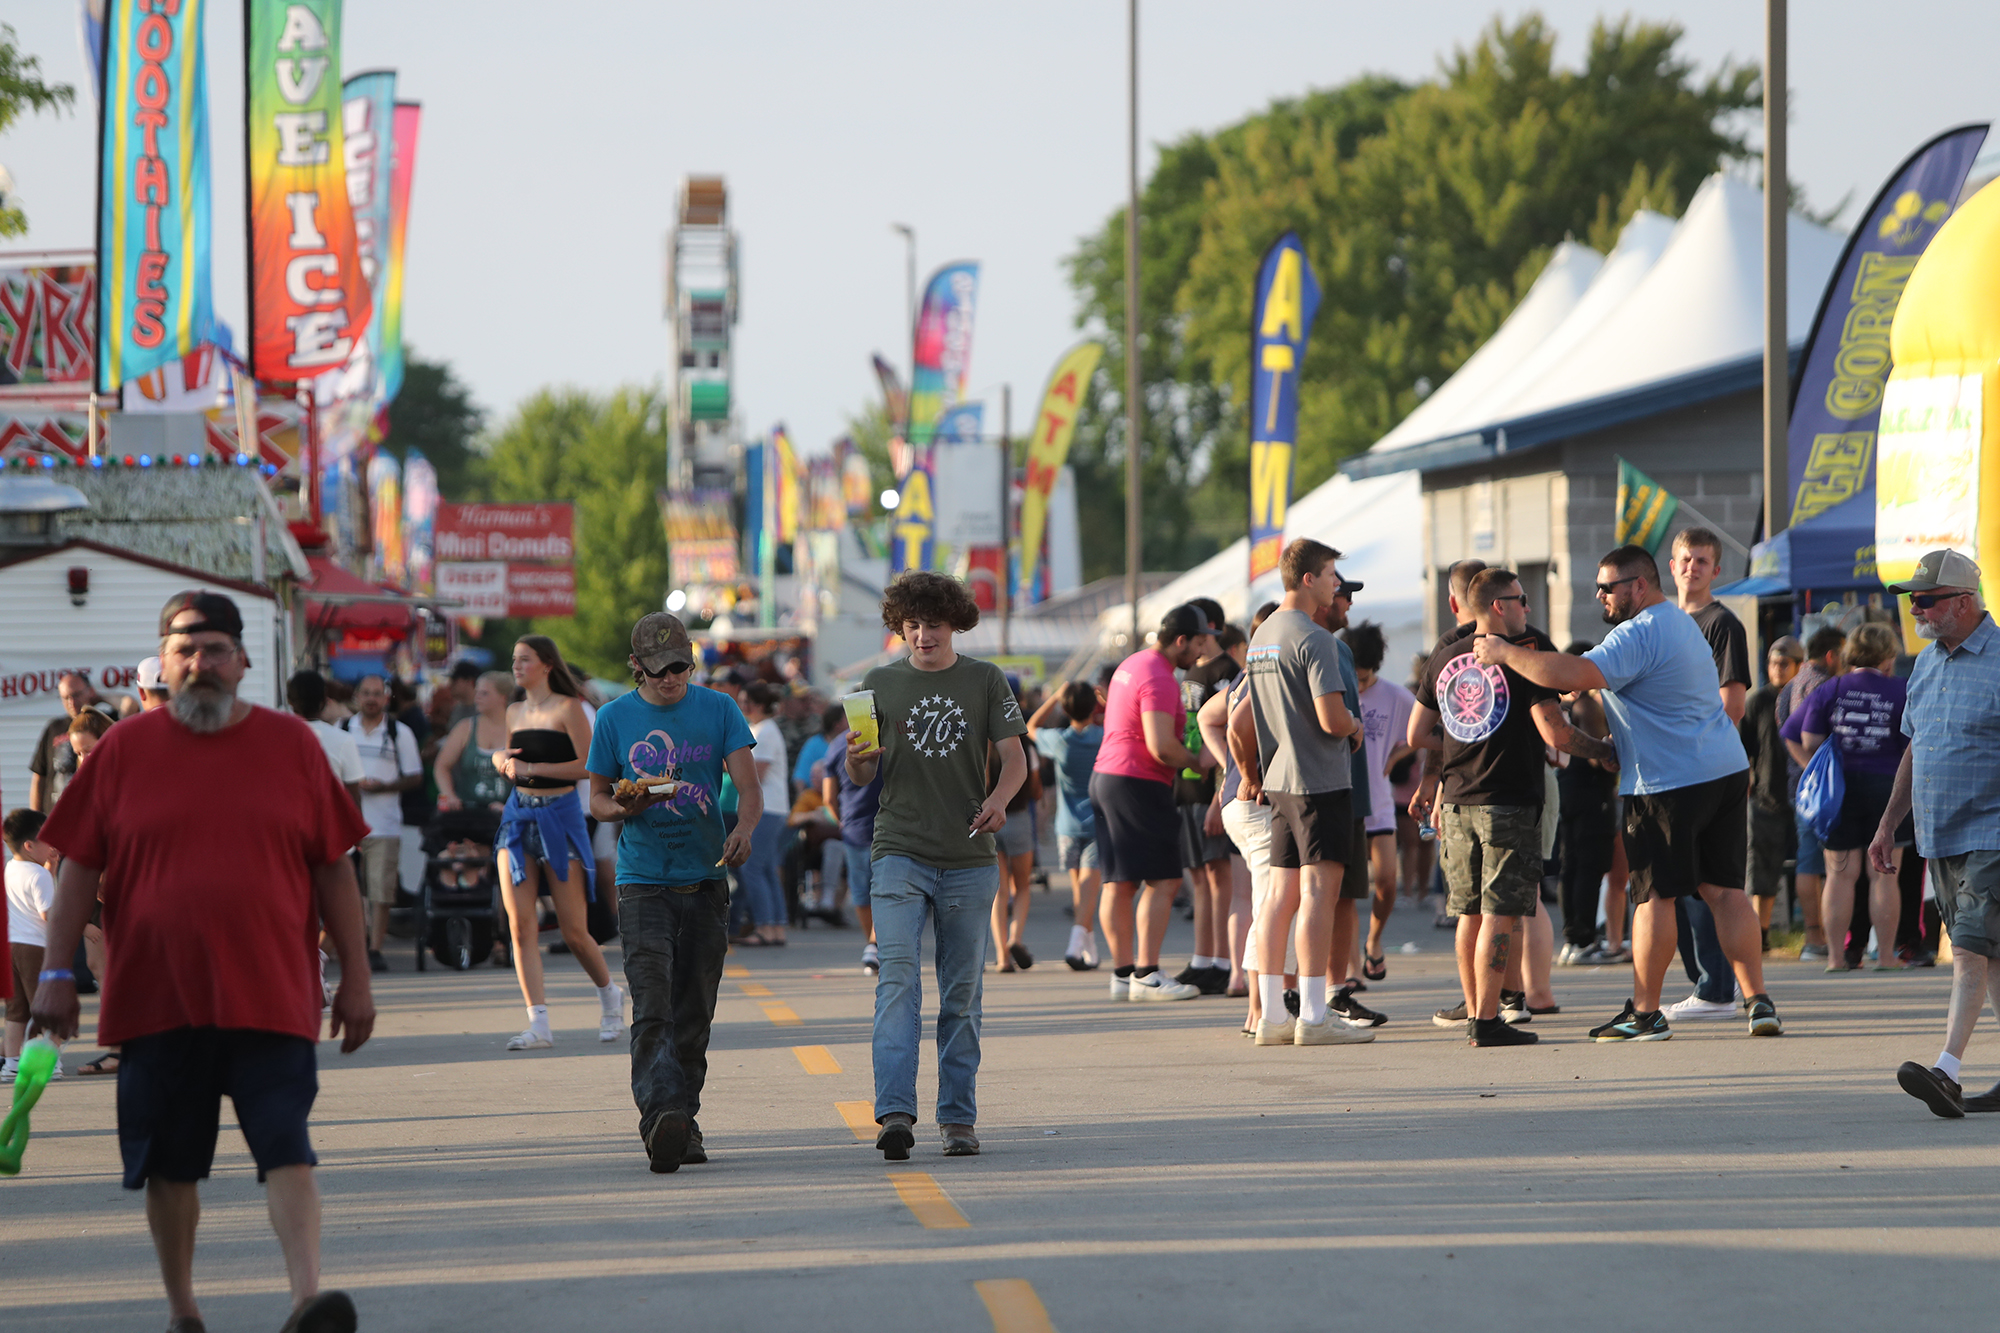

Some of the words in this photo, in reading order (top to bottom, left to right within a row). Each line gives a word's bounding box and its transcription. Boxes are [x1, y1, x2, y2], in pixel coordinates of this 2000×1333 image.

[284, 191, 353, 369] ICE
[1026, 370, 1077, 496] ATM
[436, 531, 486, 557] Mini
[487, 531, 573, 558] Donuts
[101, 666, 139, 689] OF
[921, 708, 957, 746] 76
[632, 740, 713, 769] Coaches
